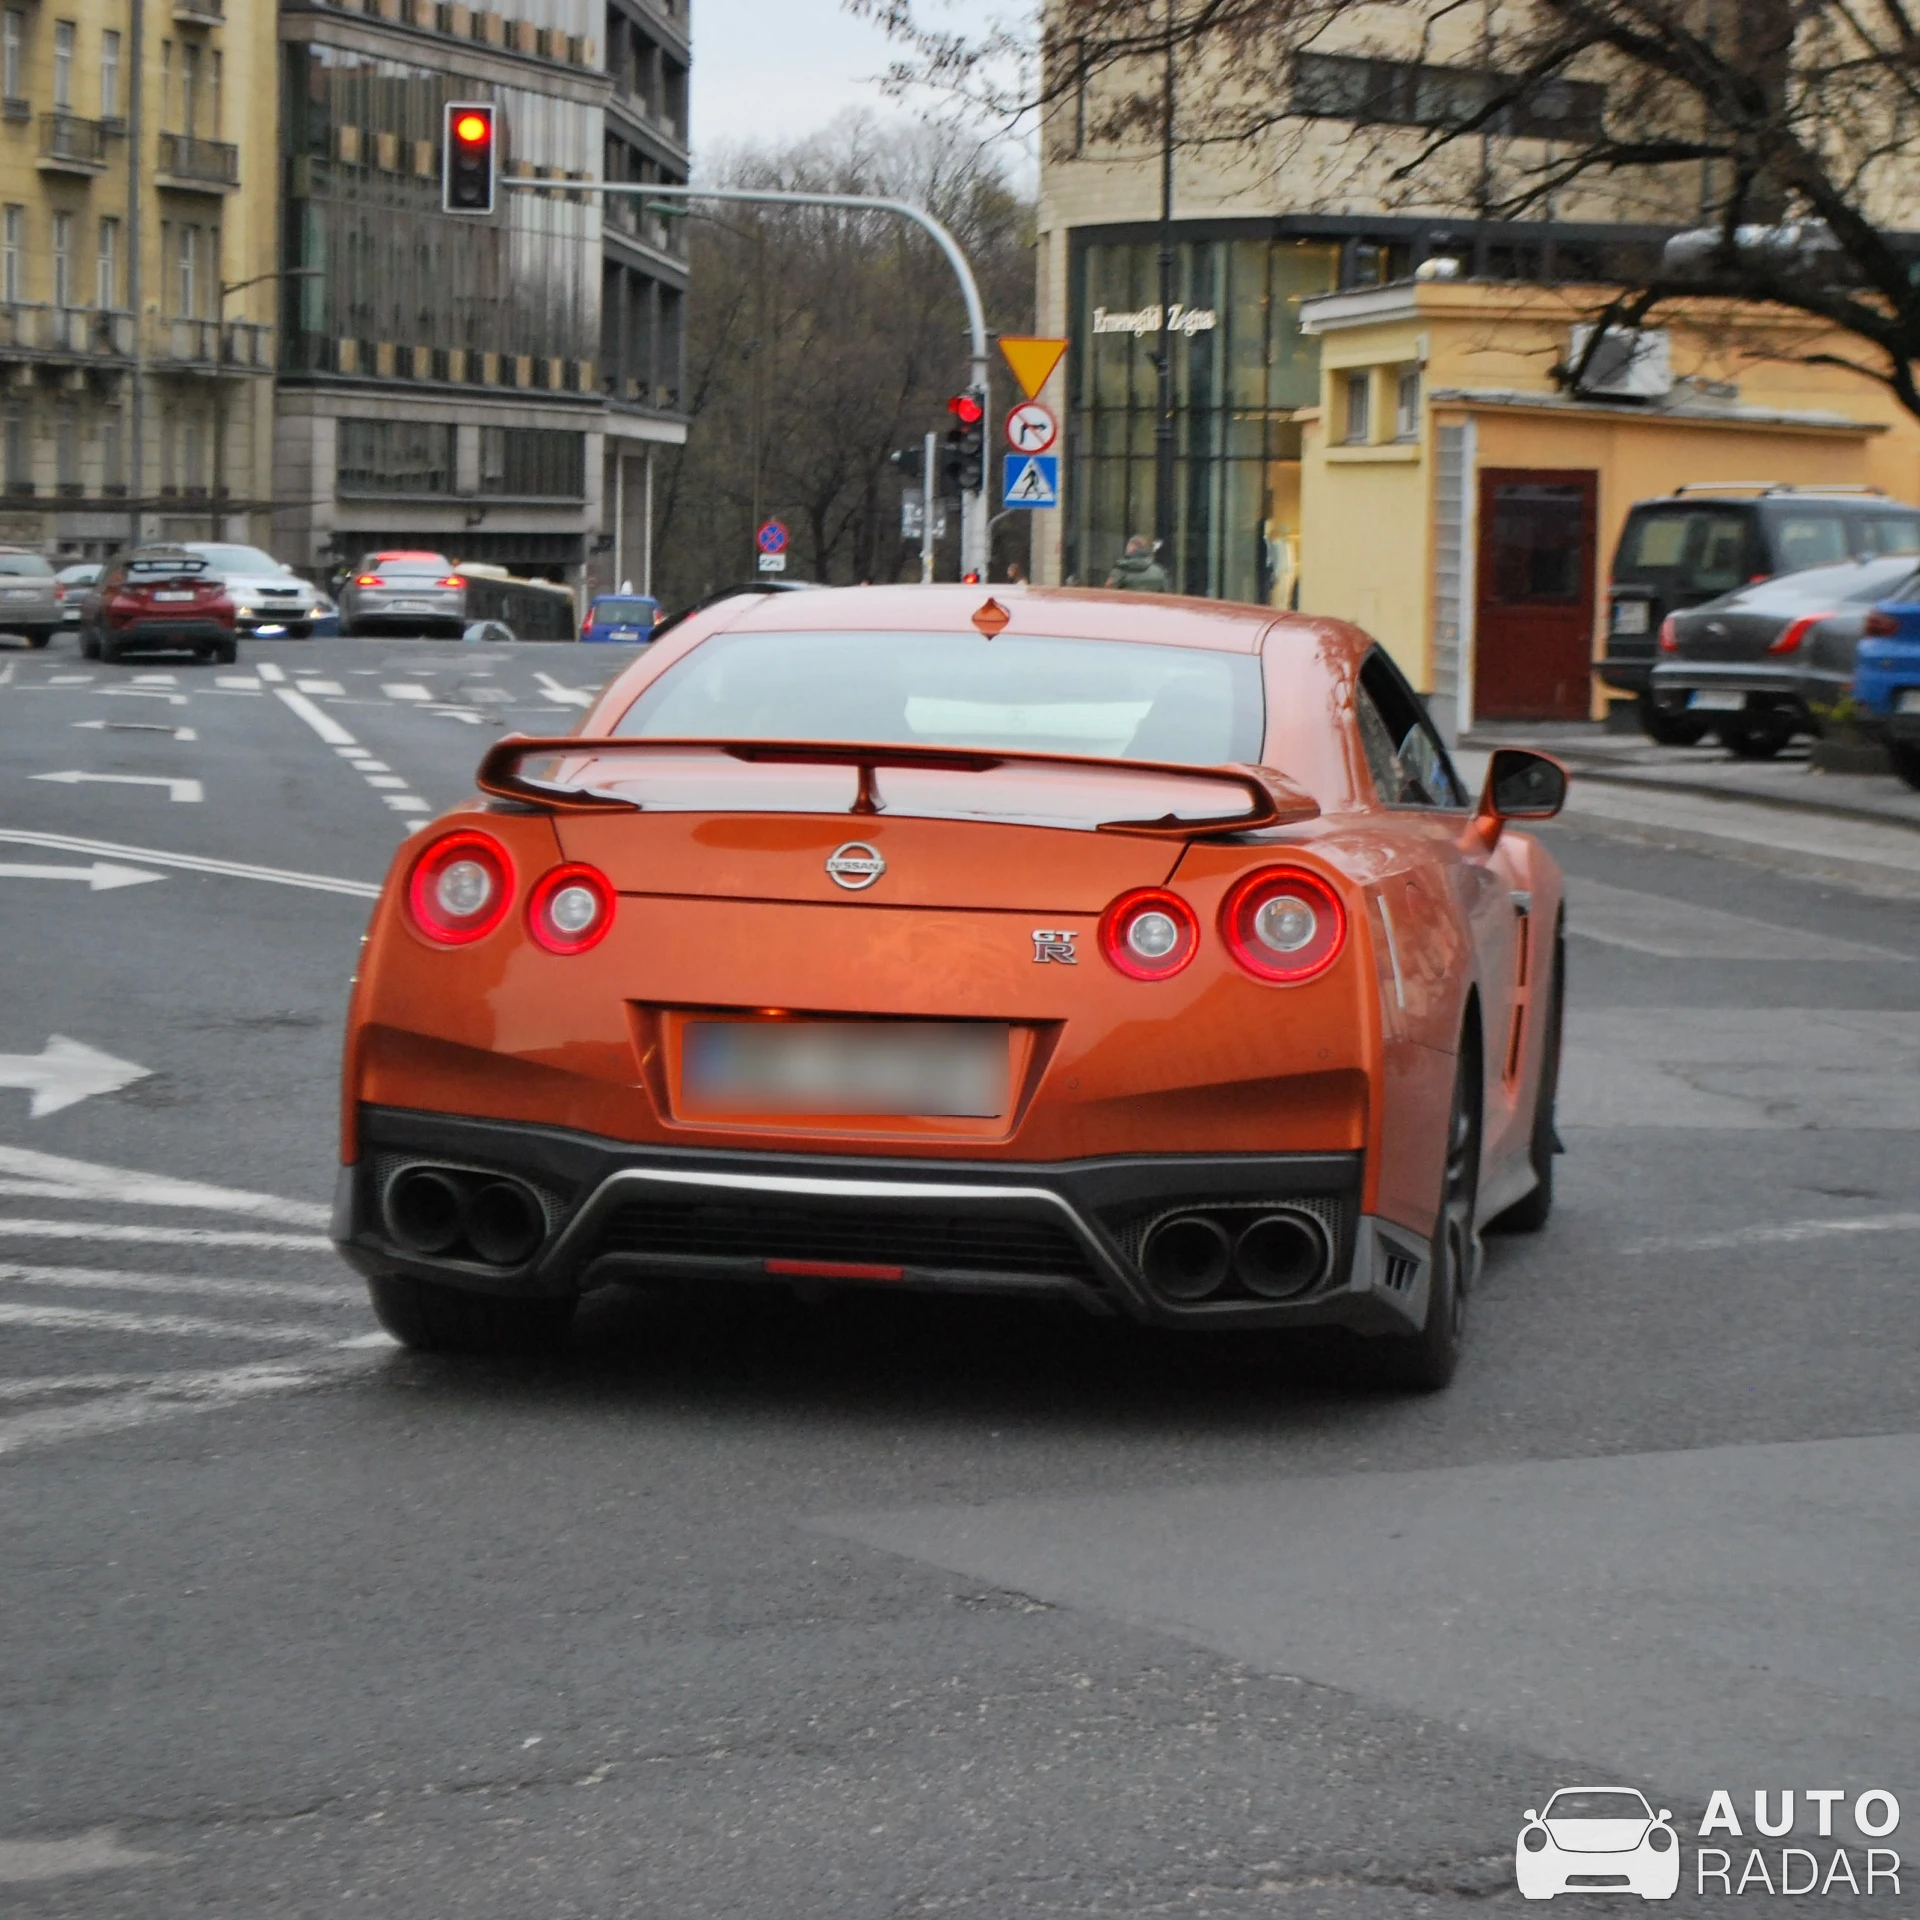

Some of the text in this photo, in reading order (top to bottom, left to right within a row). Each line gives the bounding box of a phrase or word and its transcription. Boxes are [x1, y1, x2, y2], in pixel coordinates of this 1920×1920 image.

[829, 861, 879, 871] NISSAN
[1031, 929, 1079, 943] GT
[1032, 942, 1078, 965] R
